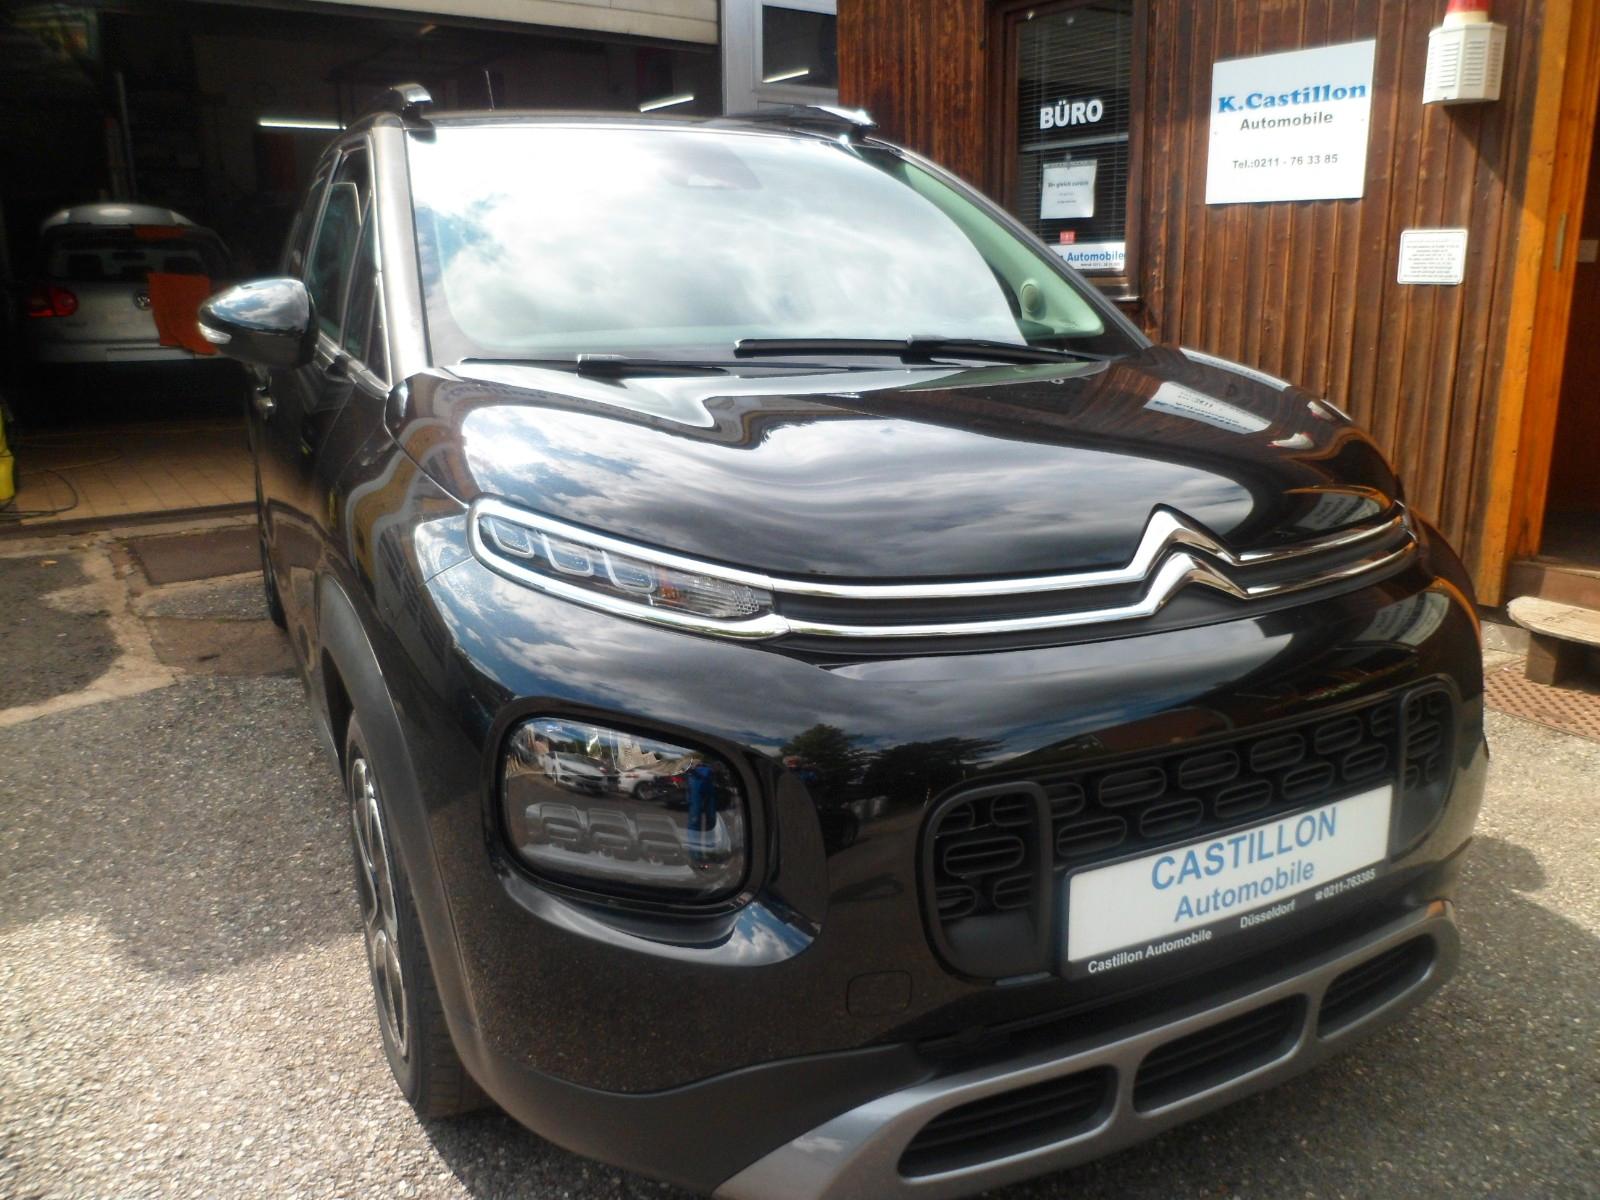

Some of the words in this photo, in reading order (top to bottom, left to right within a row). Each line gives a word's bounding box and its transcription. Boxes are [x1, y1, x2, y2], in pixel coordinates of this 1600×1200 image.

[1039, 99, 1103, 129] BÜRO
[1217, 84, 1367, 113] K.Castillon
[1240, 111, 1333, 131] Automobile
[1151, 806, 1337, 890] CASTILLON
[1174, 859, 1315, 922] Automobile
[1087, 949, 1143, 974] Castillon
[1145, 928, 1213, 959] Automobile
[1239, 899, 1297, 929] Düsseldorf
